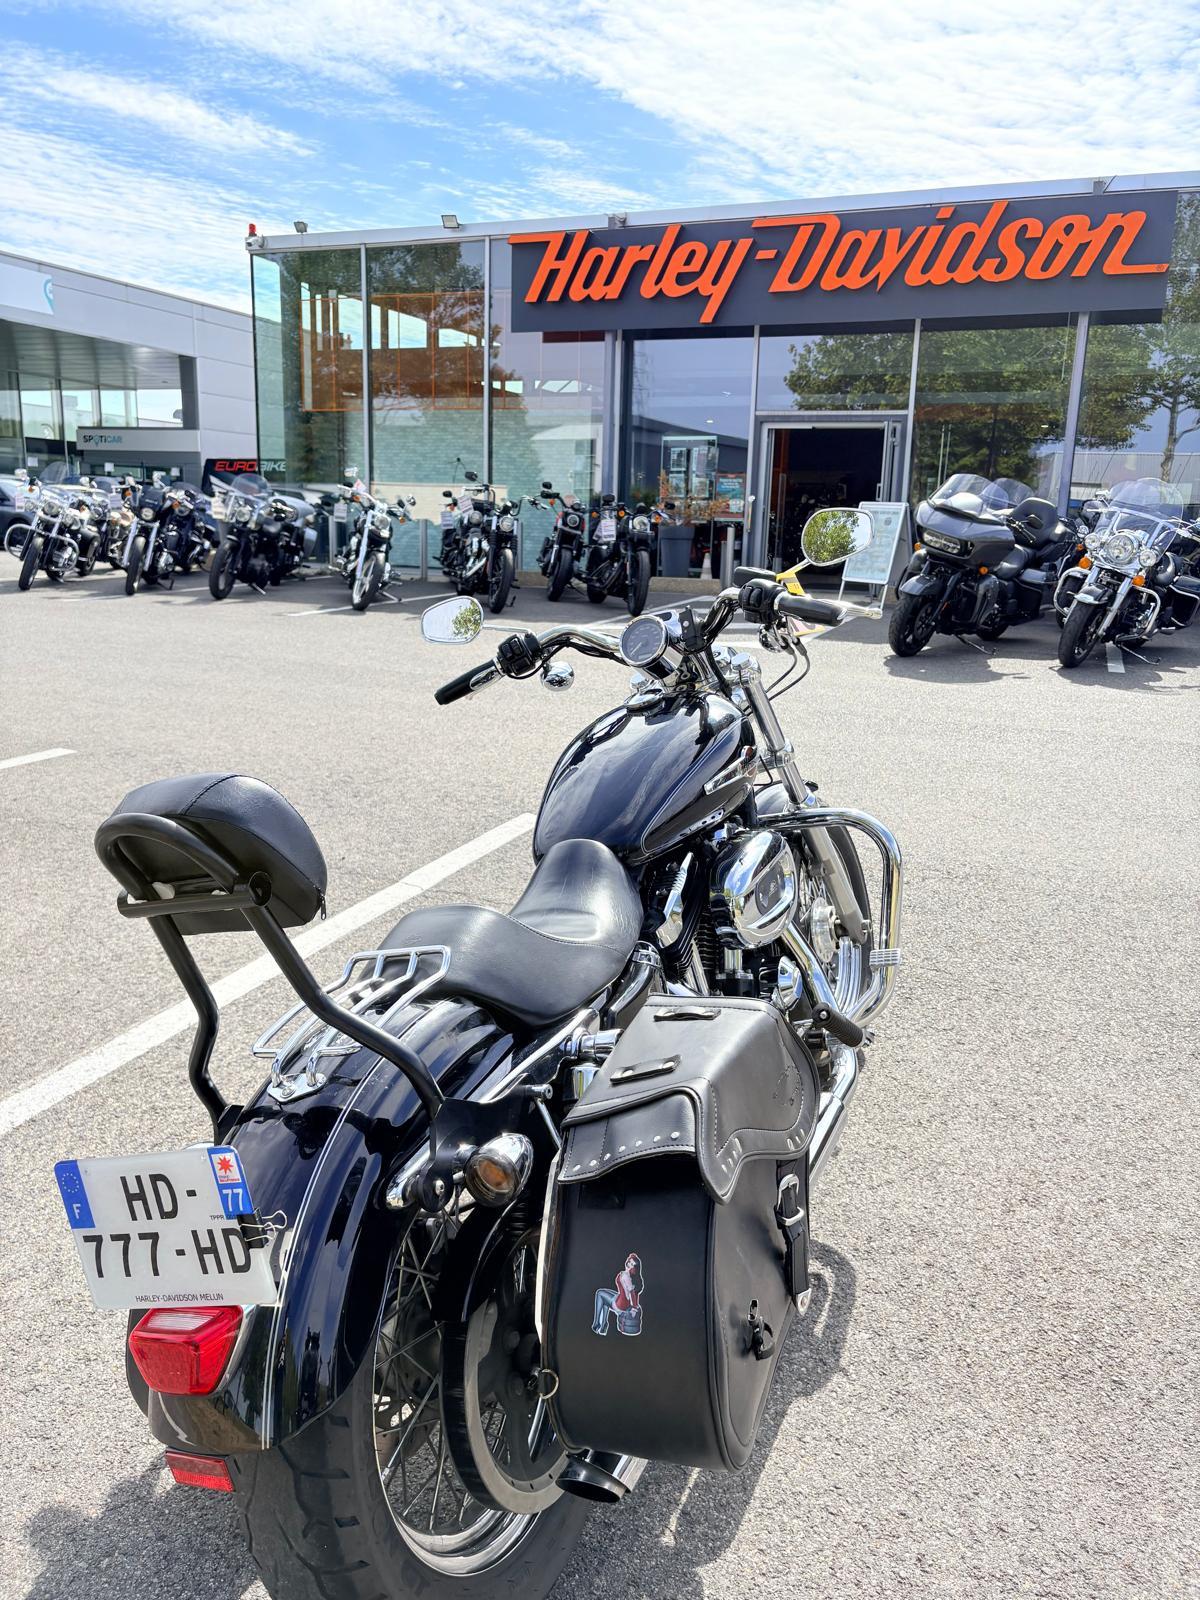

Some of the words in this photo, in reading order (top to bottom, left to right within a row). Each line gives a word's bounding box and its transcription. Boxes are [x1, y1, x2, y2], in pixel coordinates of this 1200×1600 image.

[508, 201, 1169, 323] Harley-Davidson
[222, 1188, 243, 1212] 77
[72, 1203, 81, 1219] F
[135, 1294, 198, 1302] HARLEY-DAVIDSON
[199, 1292, 224, 1301] MELUN
